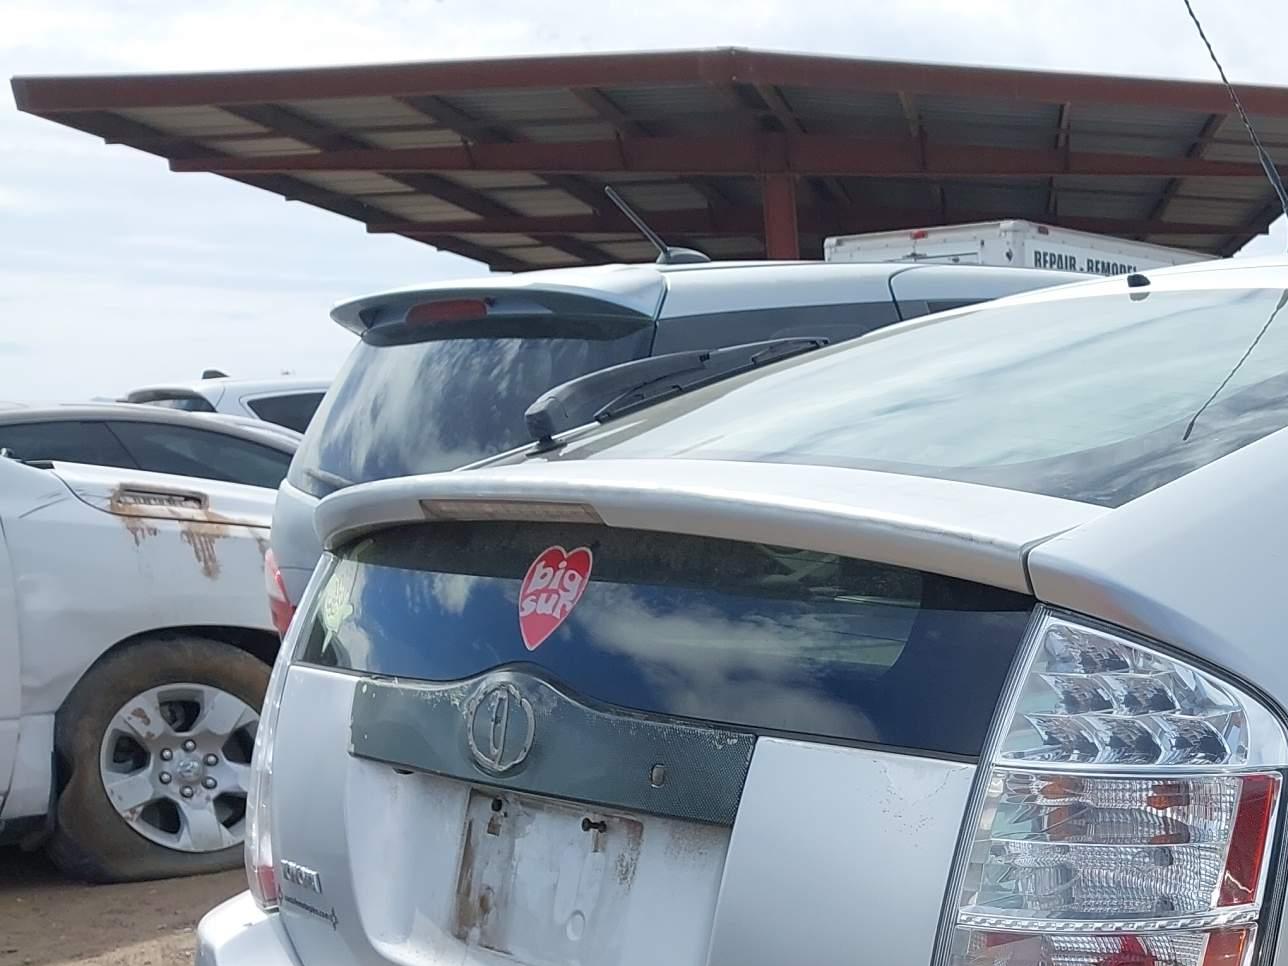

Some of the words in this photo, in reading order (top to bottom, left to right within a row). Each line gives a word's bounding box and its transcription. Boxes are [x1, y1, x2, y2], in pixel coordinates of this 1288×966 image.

[1034, 250, 1077, 272] REPAIR
[1086, 257, 1137, 276] REMOD
[527, 560, 583, 600] big
